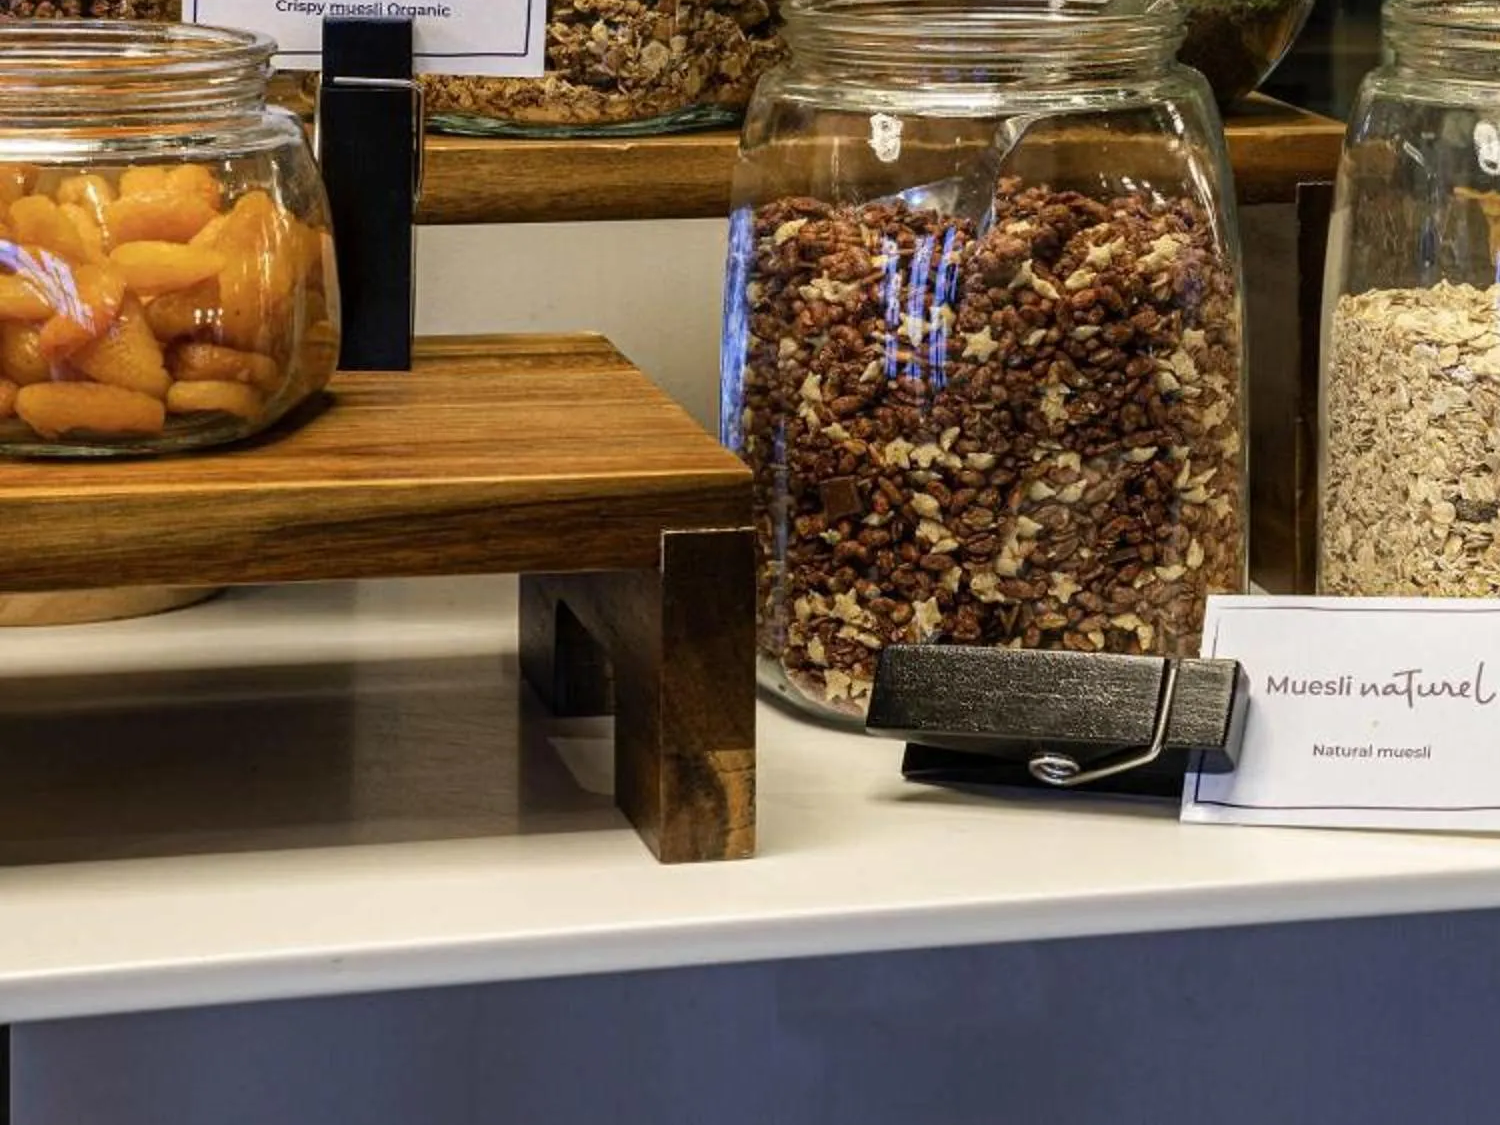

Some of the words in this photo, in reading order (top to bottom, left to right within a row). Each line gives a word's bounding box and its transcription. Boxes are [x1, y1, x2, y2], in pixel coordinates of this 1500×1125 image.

[329, 1, 383, 16] muesli
[387, 2, 452, 18] Organic
[1265, 674, 1352, 697] Muesli
[1360, 661, 1497, 709] naturel
[1312, 743, 1373, 759] Natural
[1377, 744, 1432, 760] muesli
